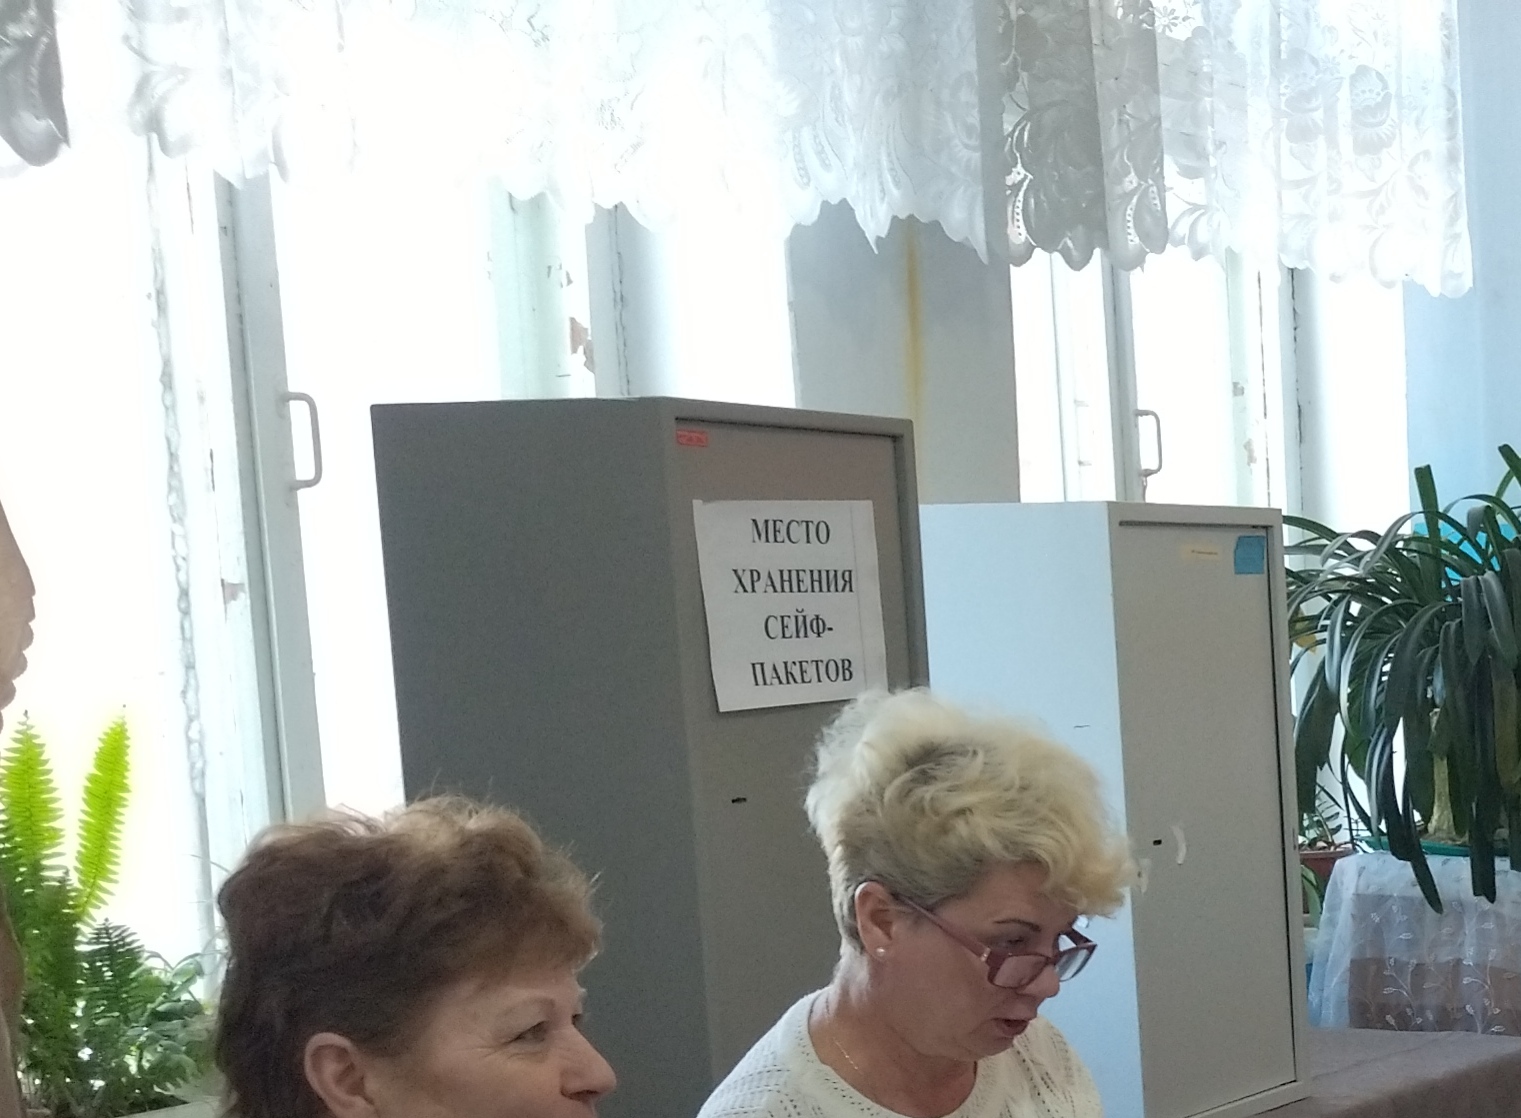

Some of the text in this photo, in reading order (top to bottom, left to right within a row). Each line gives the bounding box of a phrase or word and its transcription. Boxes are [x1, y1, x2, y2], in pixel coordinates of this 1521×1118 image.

[750, 518, 831, 545] МЕСТО
[732, 568, 854, 594] ХРАНЕНИЯ
[764, 609, 833, 640] СЕЙФ-
[750, 658, 853, 687] ПАКЕТОВ
